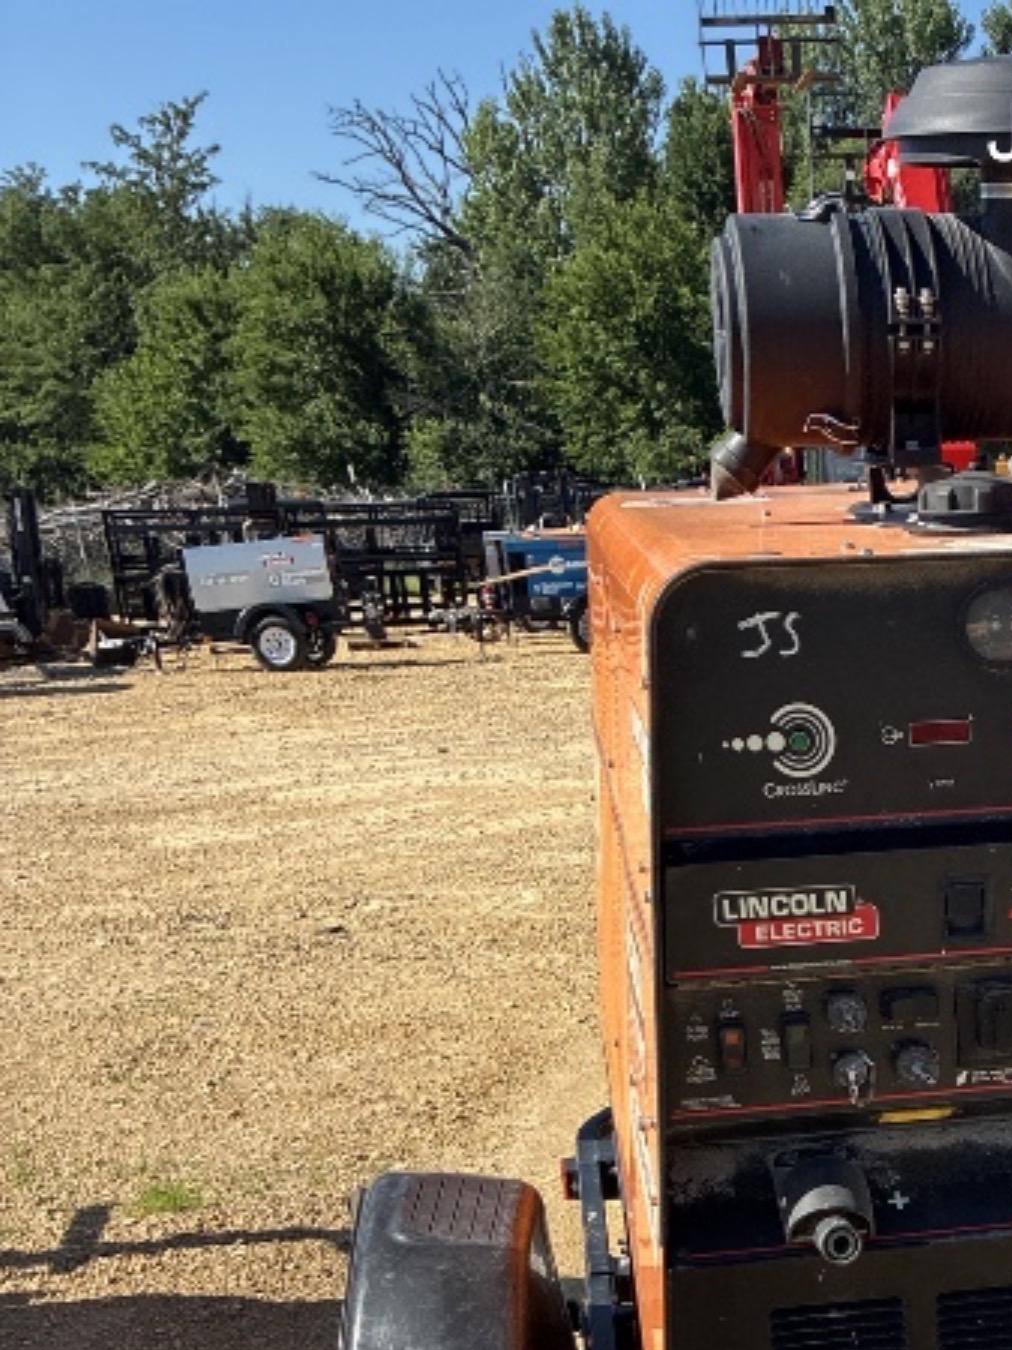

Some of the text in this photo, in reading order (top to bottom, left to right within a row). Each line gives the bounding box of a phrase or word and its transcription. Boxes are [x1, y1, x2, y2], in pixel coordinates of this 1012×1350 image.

[737, 611, 801, 658] JS
[721, 889, 848, 919] LINCOLN
[755, 917, 865, 942] ELECTRIC
